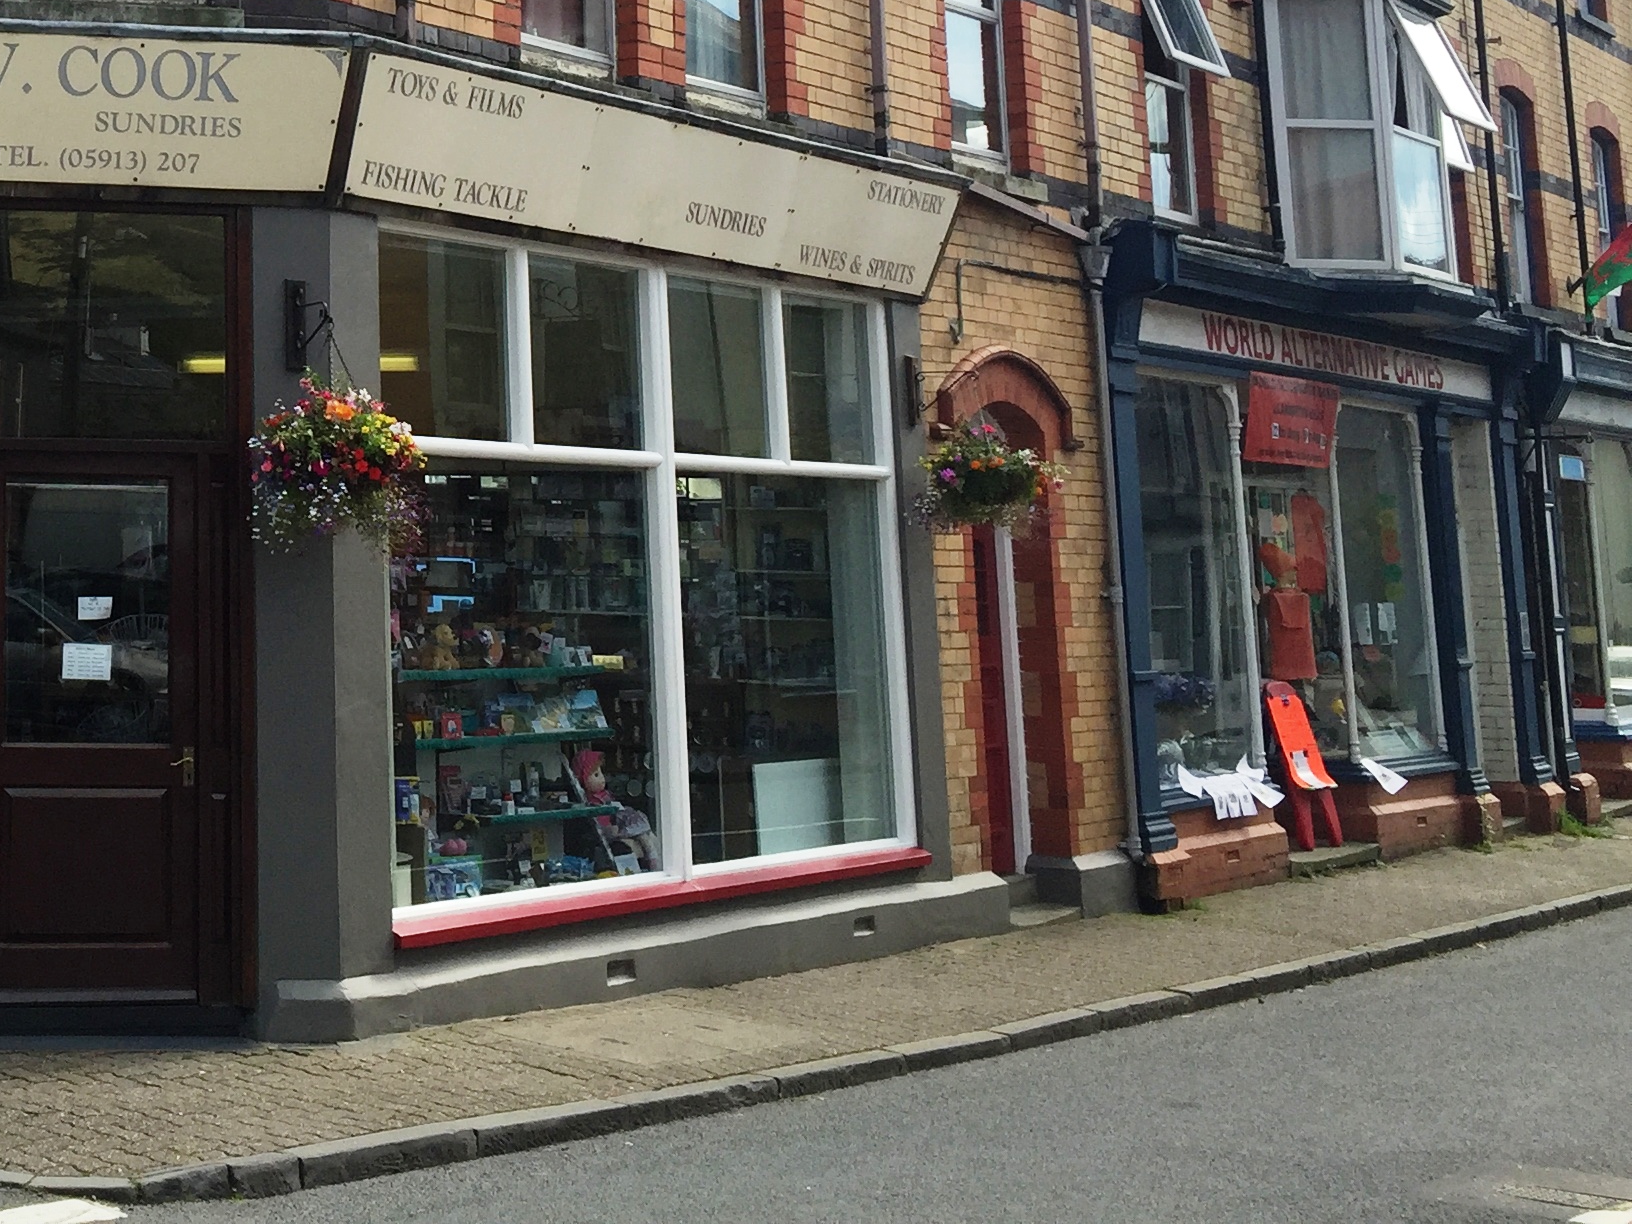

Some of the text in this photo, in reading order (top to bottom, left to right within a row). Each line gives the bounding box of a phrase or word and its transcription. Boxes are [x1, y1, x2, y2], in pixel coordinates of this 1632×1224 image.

[57, 44, 242, 104] COOK
[387, 68, 526, 119] TOYS & FILMS
[94, 111, 243, 139] SUNDRIES
[59, 147, 148, 172] (05913)
[157, 152, 200, 175] 207
[361, 160, 528, 213] FISHING TACKLE
[868, 180, 945, 216] STATIONERY
[686, 202, 767, 238] SUNDRIES
[799, 244, 916, 286] WINES & SPIRITS
[1202, 313, 1275, 360] WORLD
[1281, 327, 1391, 381] ALTERNATIVE
[1392, 349, 1444, 390] GAMES
